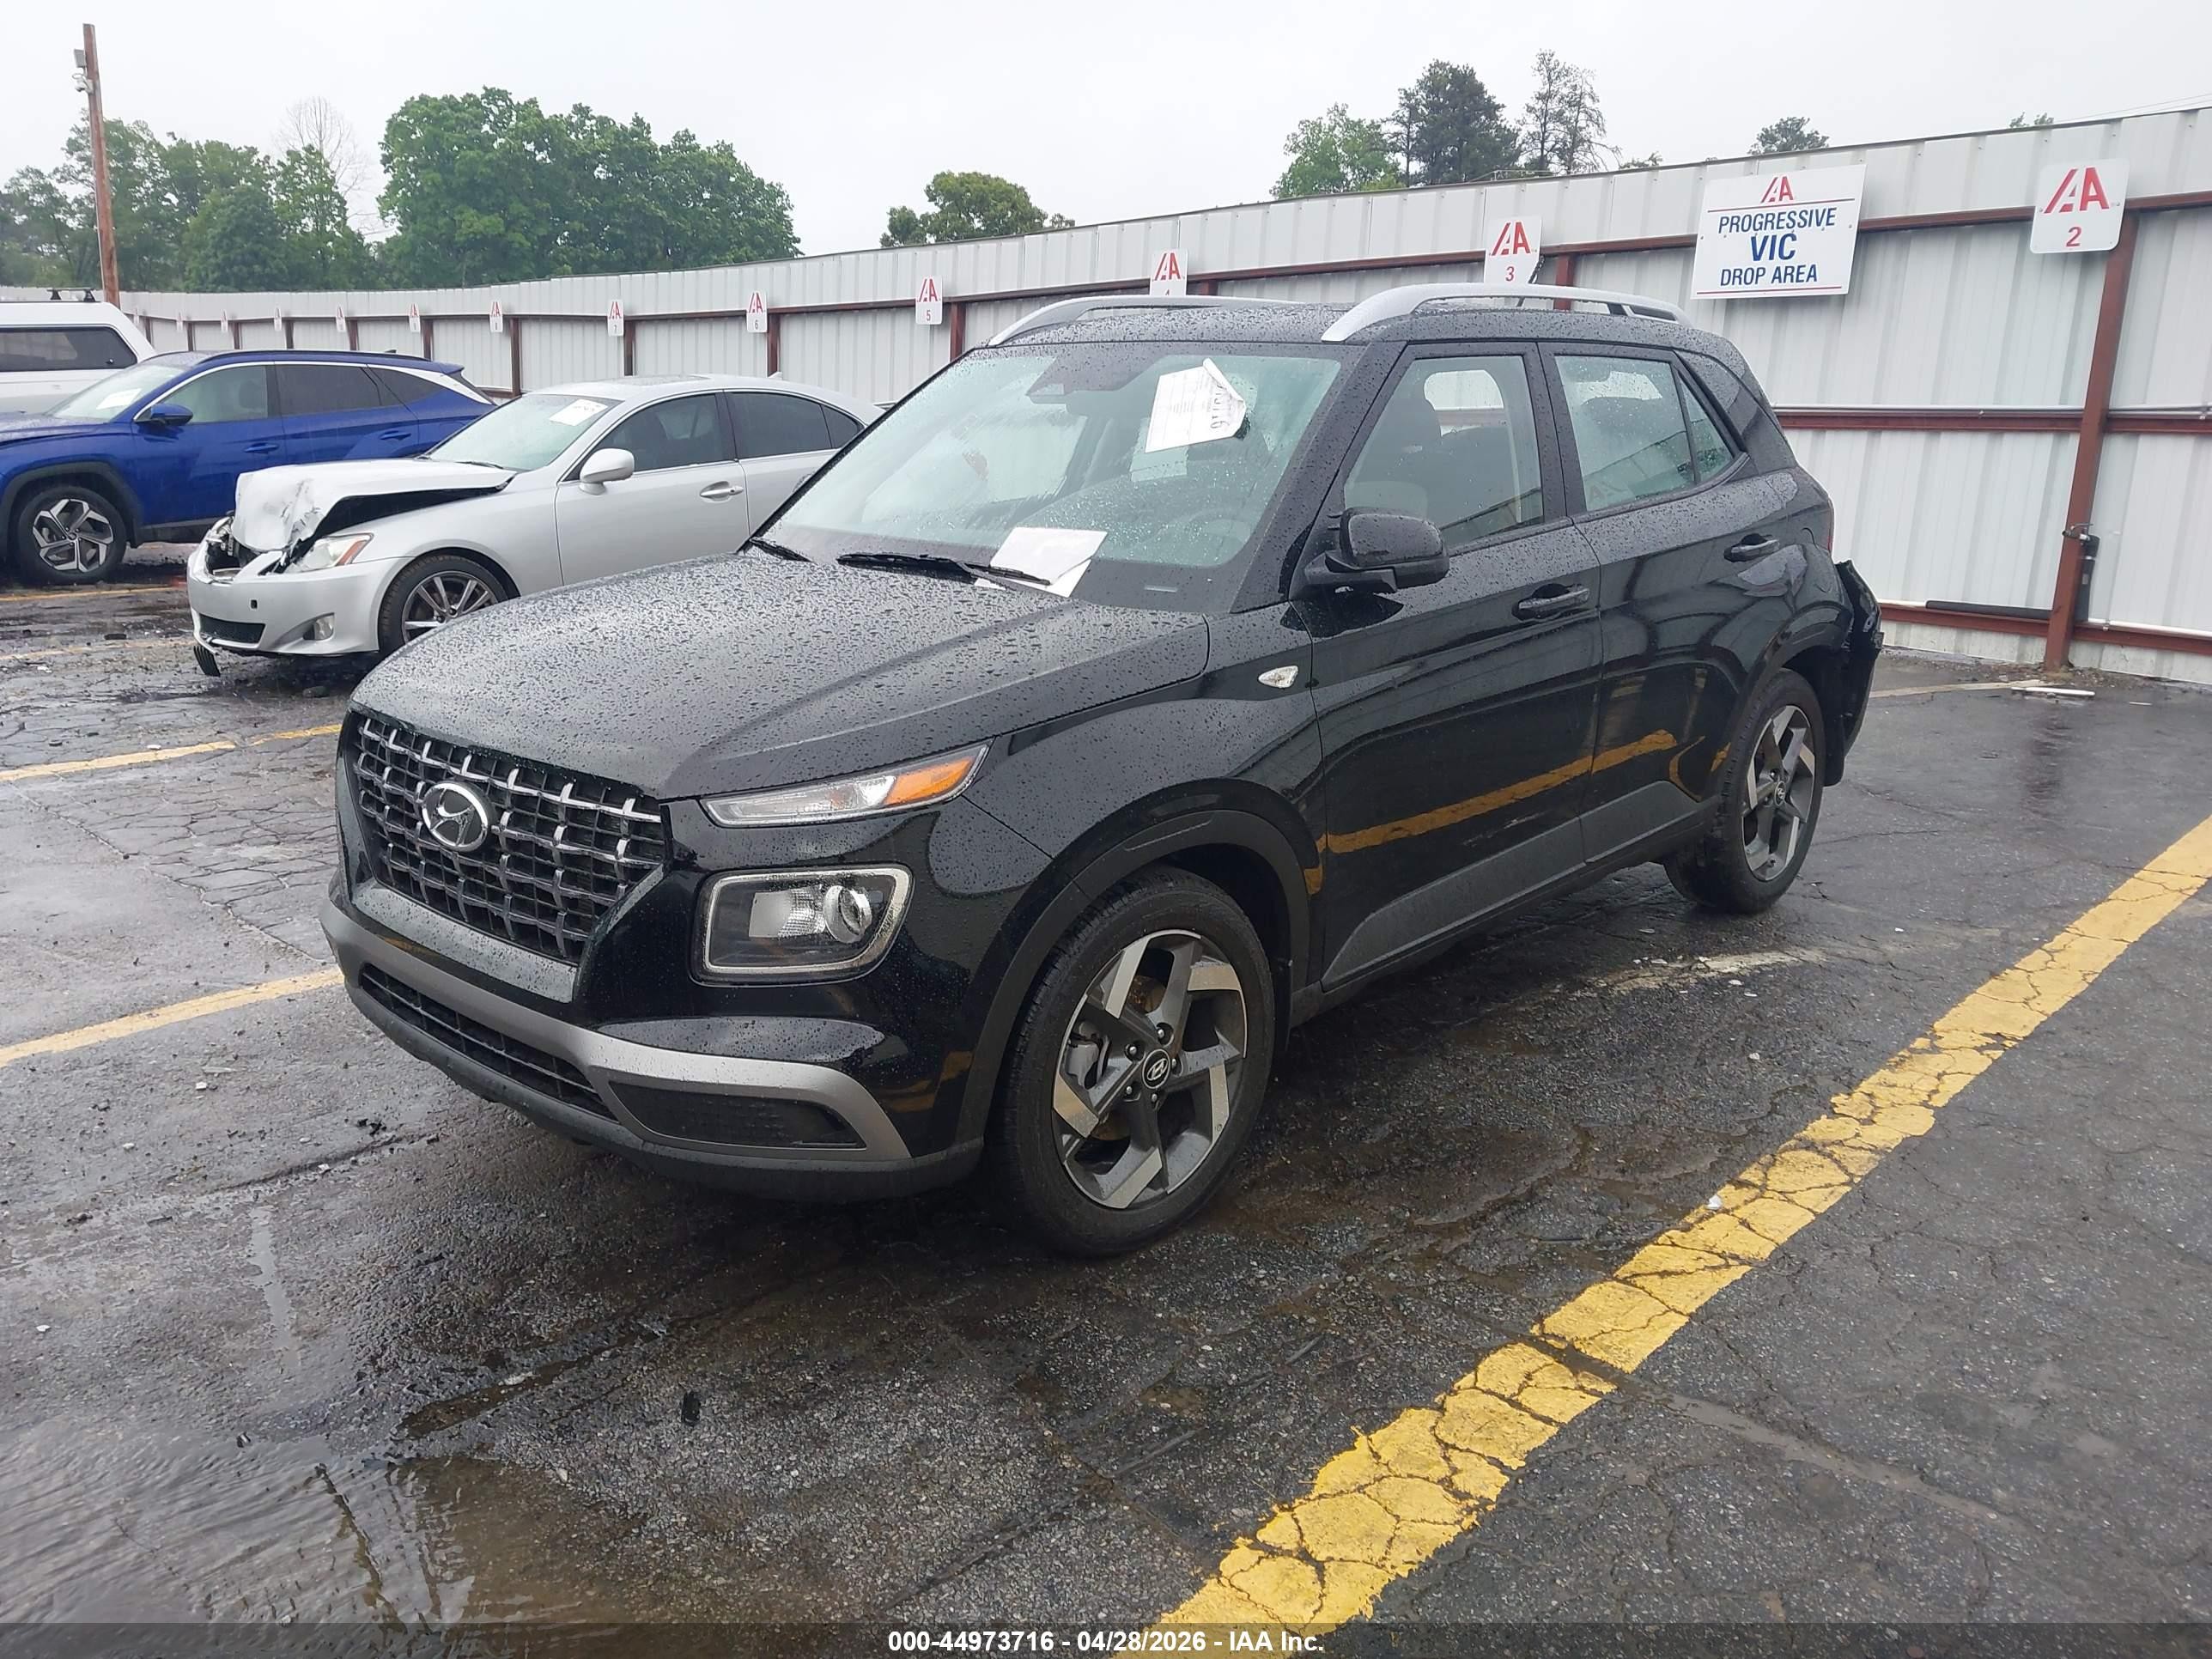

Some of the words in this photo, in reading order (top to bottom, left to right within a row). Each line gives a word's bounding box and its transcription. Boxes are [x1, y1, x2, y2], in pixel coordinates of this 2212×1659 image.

[1718, 207, 1838, 234] PROGRESSIVE
[1750, 233, 1797, 261] VIC
[2065, 226, 2082, 247] 2
[1505, 265, 1515, 282] 3
[1720, 267, 1766, 287] DROP
[1771, 264, 1818, 283] AREA
[926, 309, 932, 321] 5
